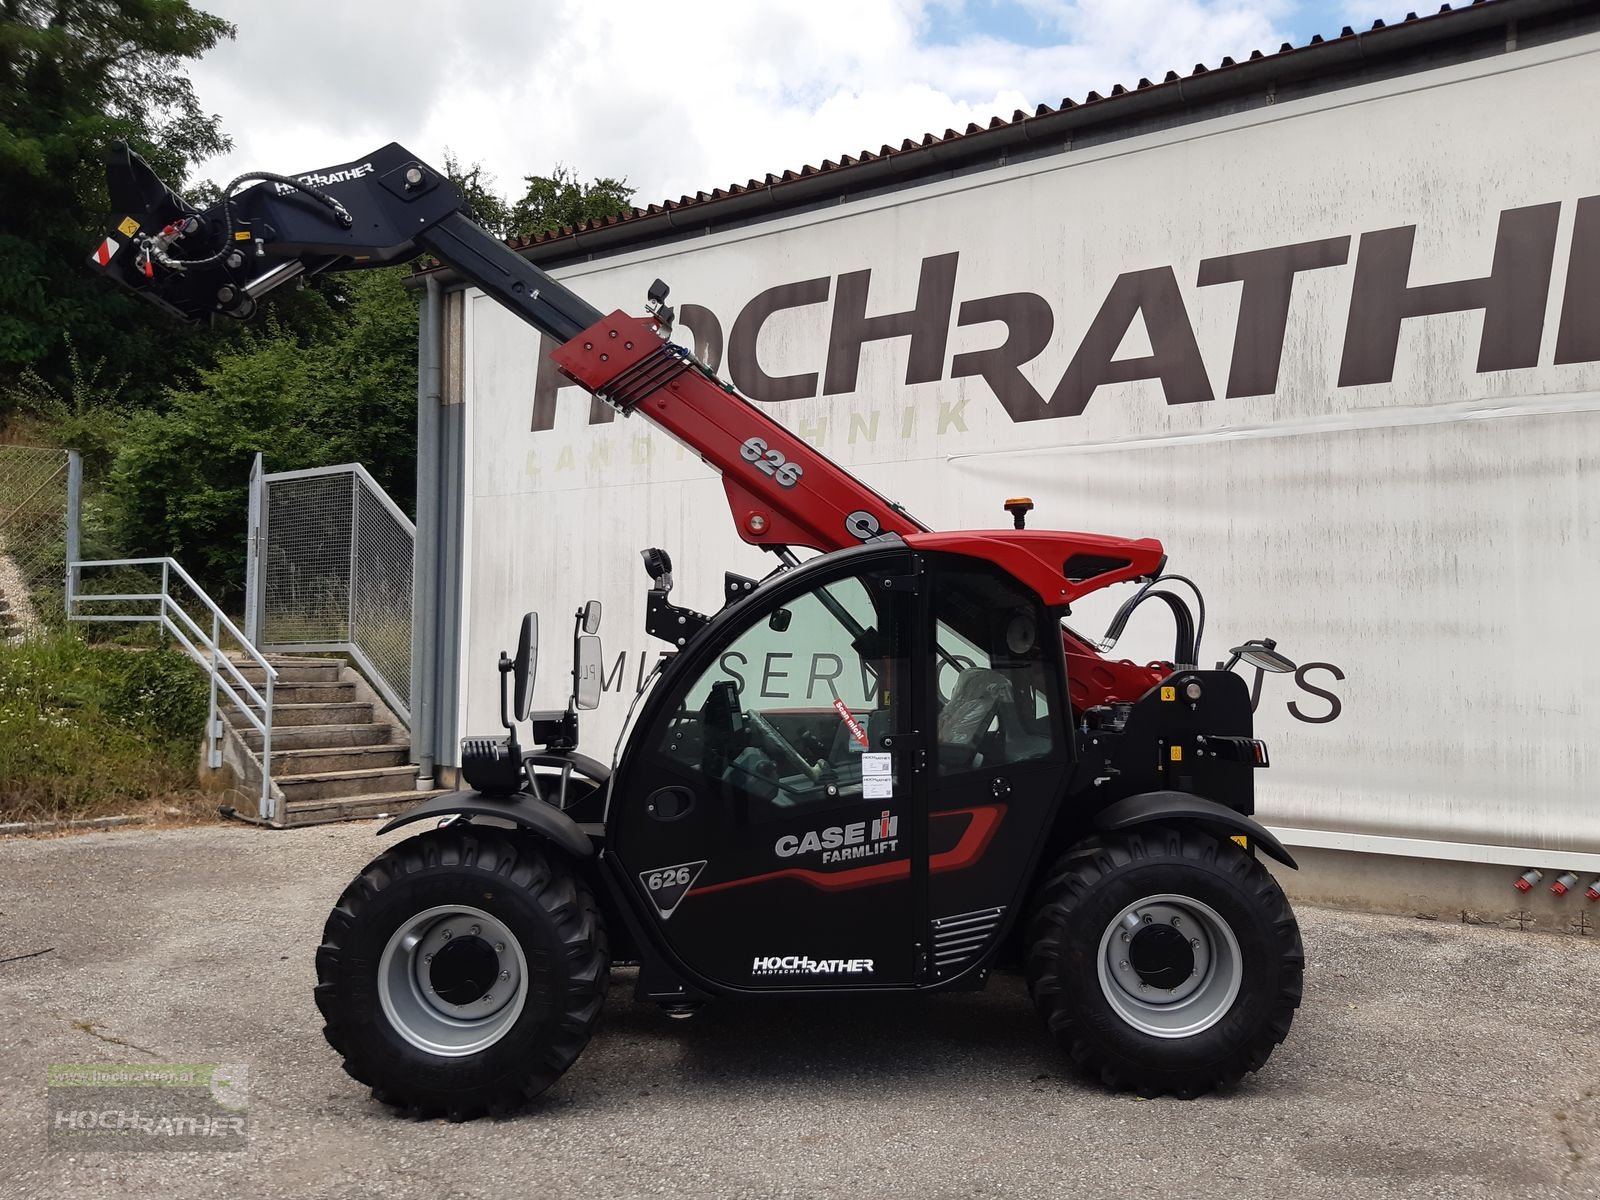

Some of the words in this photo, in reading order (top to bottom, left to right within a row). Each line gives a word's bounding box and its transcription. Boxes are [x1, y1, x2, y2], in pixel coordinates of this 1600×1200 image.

[739, 436, 804, 489] 626
[835, 701, 850, 720] Scan
[847, 719, 865, 740] mich!
[774, 821, 866, 858] CASE
[822, 839, 899, 864] FARMLIFT
[648, 867, 690, 890] 626
[752, 955, 874, 973] HOCHRATHER
